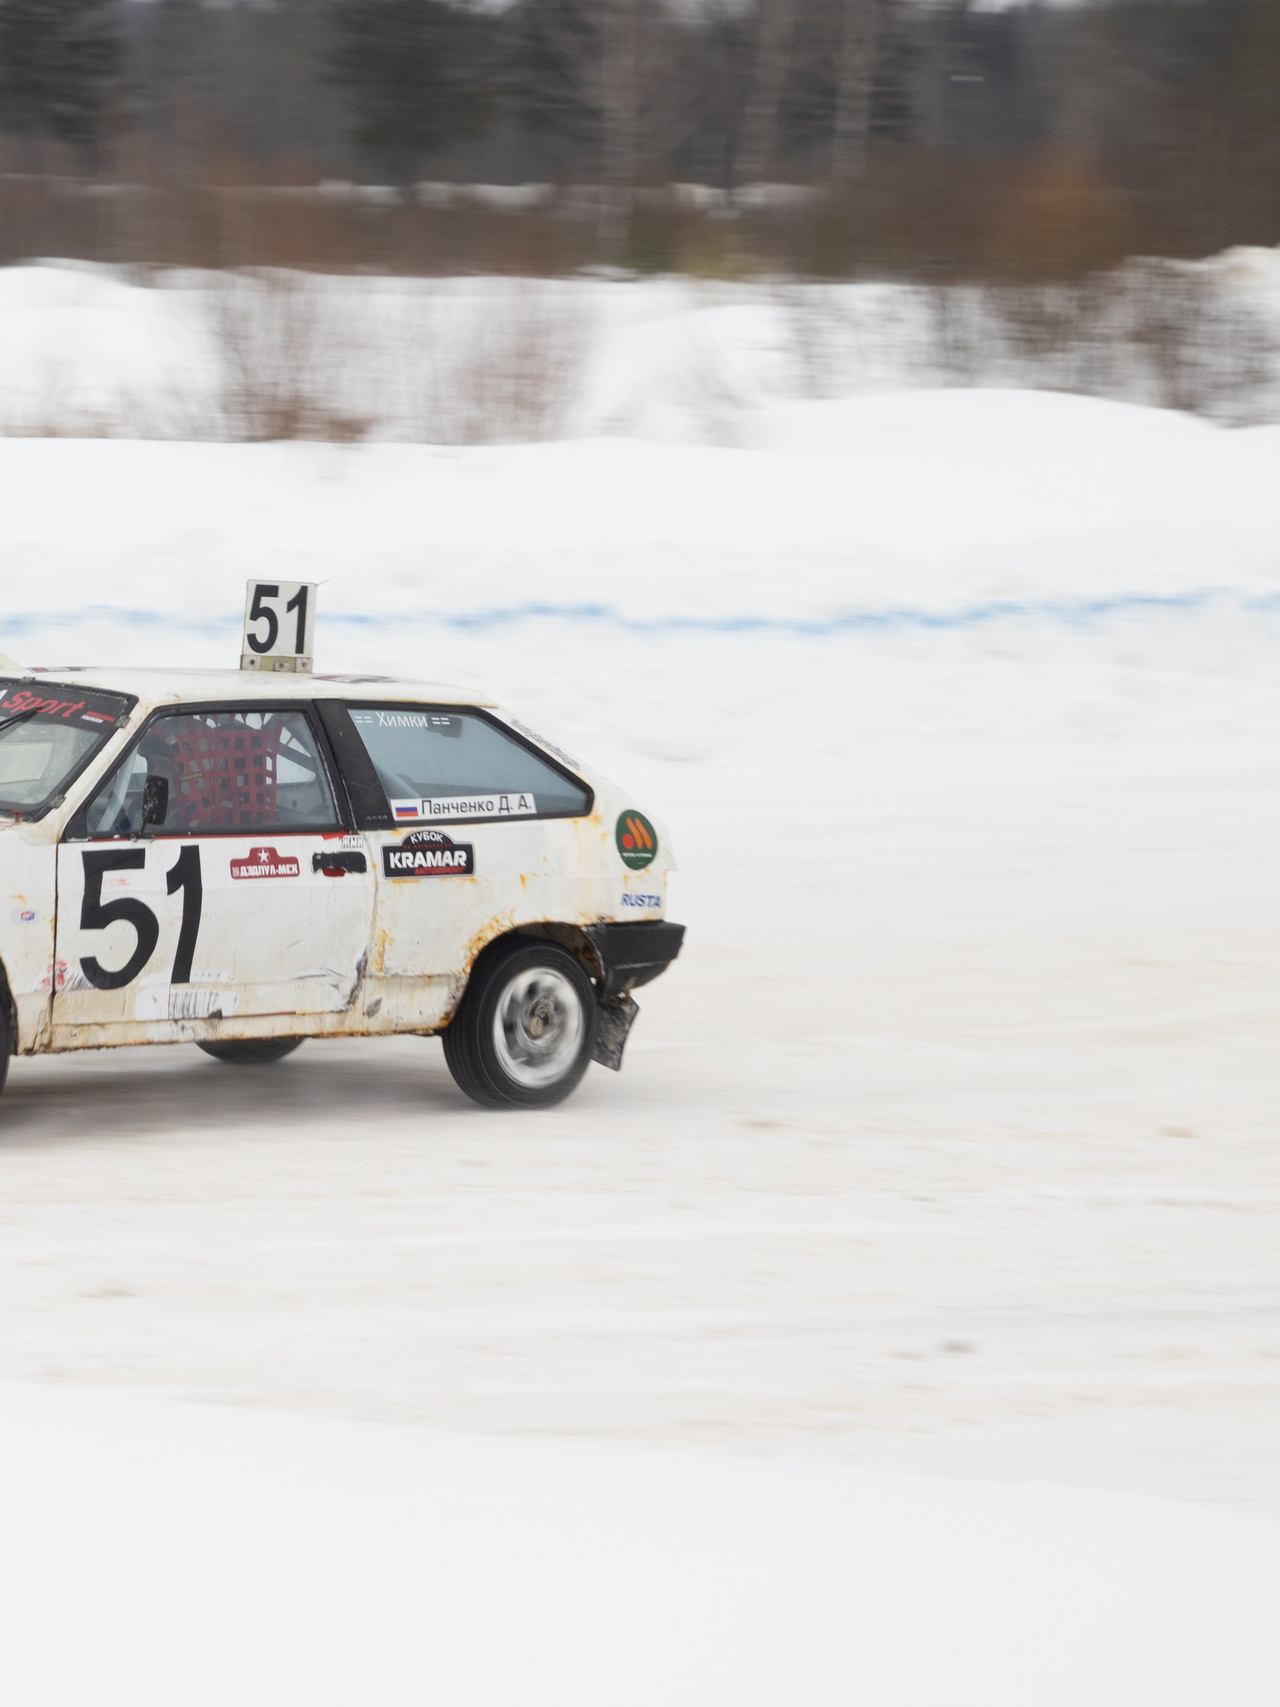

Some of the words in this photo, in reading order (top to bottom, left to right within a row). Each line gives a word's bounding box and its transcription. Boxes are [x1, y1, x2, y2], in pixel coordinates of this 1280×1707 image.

[246, 583, 309, 655] 51
[1, 690, 86, 718] Sport
[375, 711, 429, 728] Химки
[421, 799, 494, 815] Панченко
[498, 795, 514, 814] Д.
[517, 794, 532, 810] А.
[409, 831, 444, 844] КУБОК
[389, 850, 467, 869] KRAMAR
[621, 893, 662, 908] RUSTA
[79, 844, 203, 991] 51
